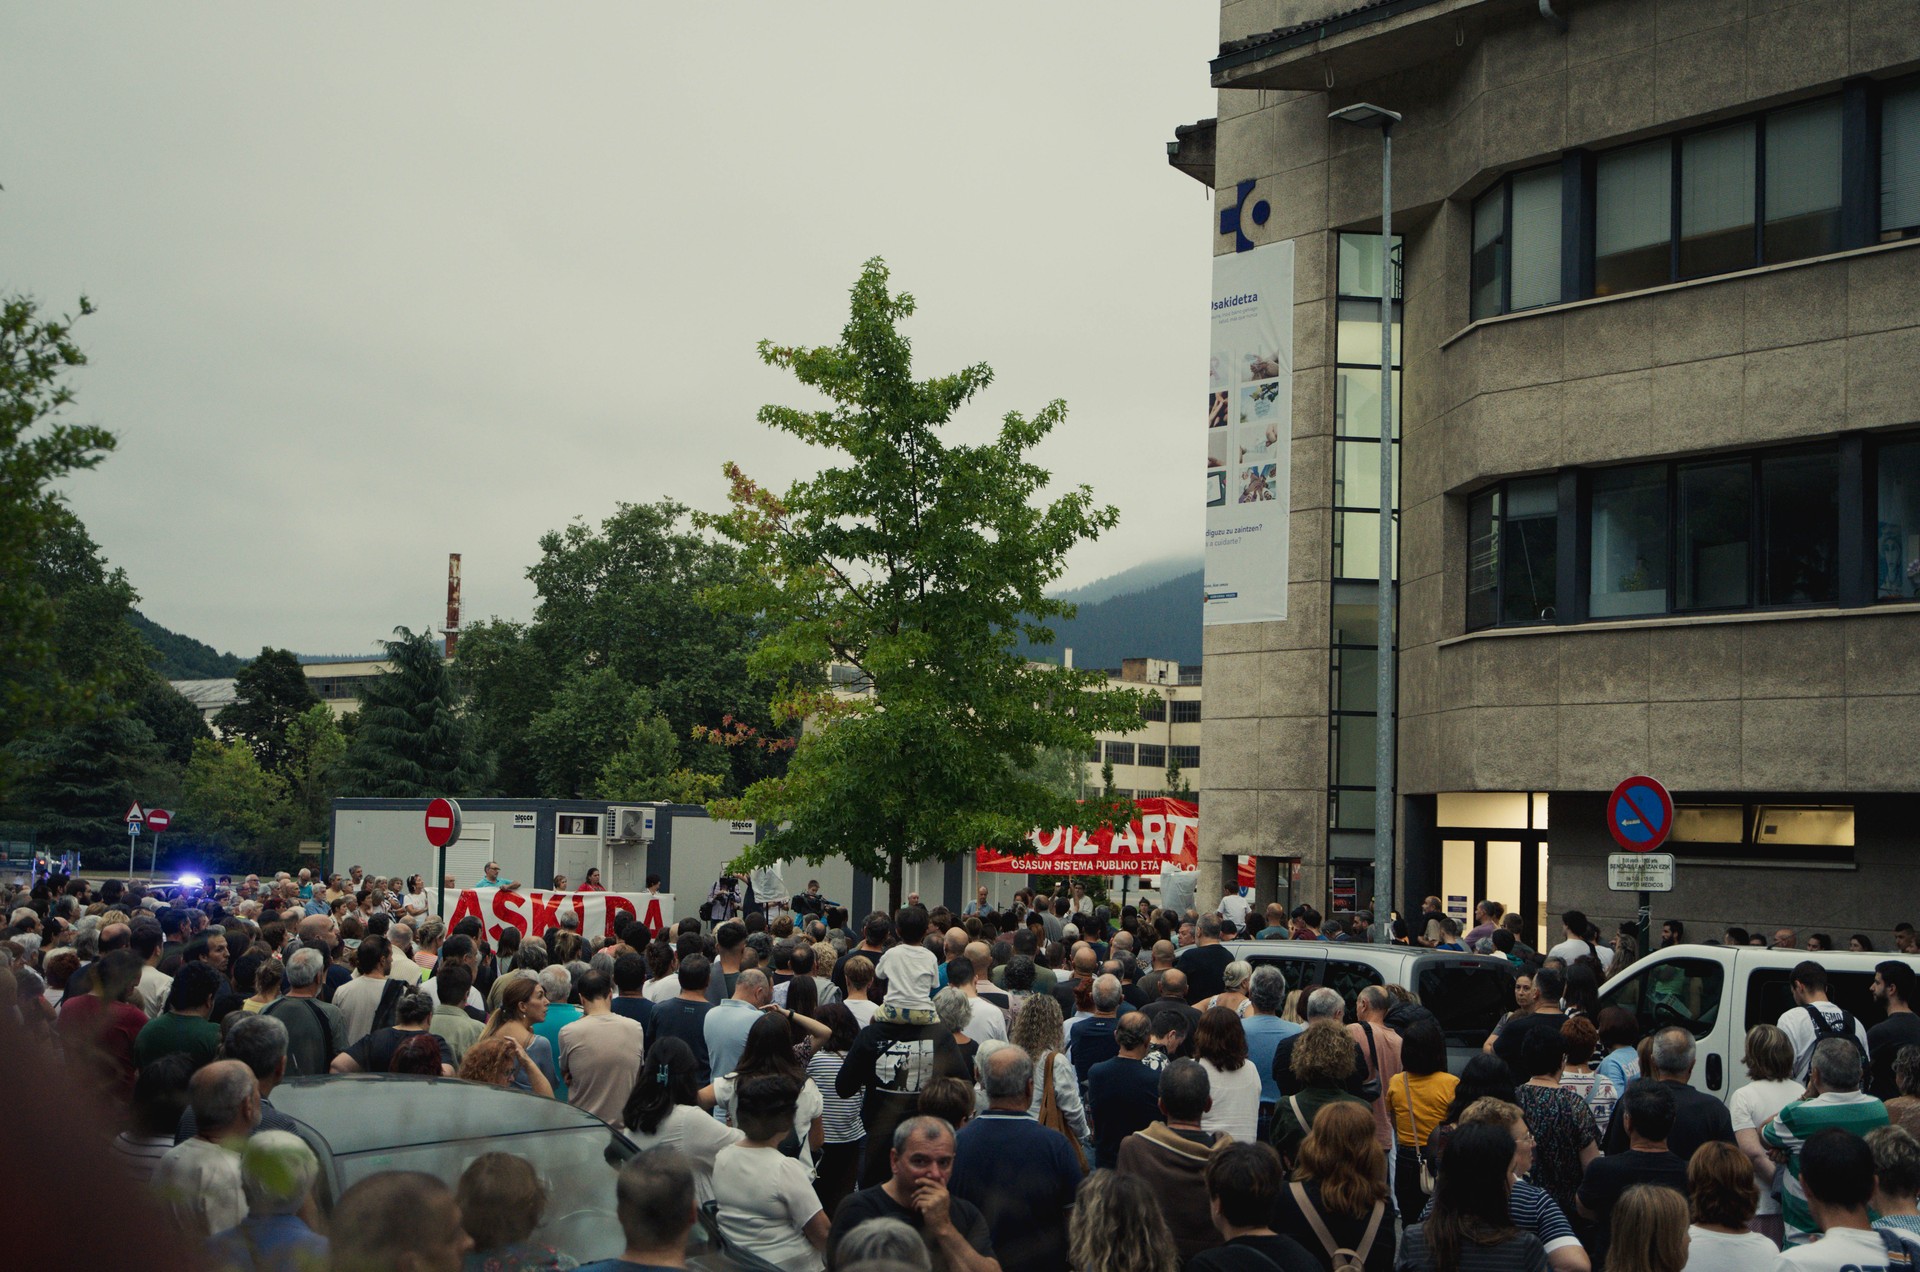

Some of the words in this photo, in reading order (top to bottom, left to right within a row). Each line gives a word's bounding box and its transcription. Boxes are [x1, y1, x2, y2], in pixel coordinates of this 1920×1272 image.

[1234, 524, 1263, 534] zaintzen?
[575, 821, 581, 832] 2
[1011, 860, 1052, 870] OSASUN
[1054, 860, 1094, 871] SISTEMA
[1095, 860, 1139, 870] PUBLIKO
[1140, 860, 1160, 870] ETA
